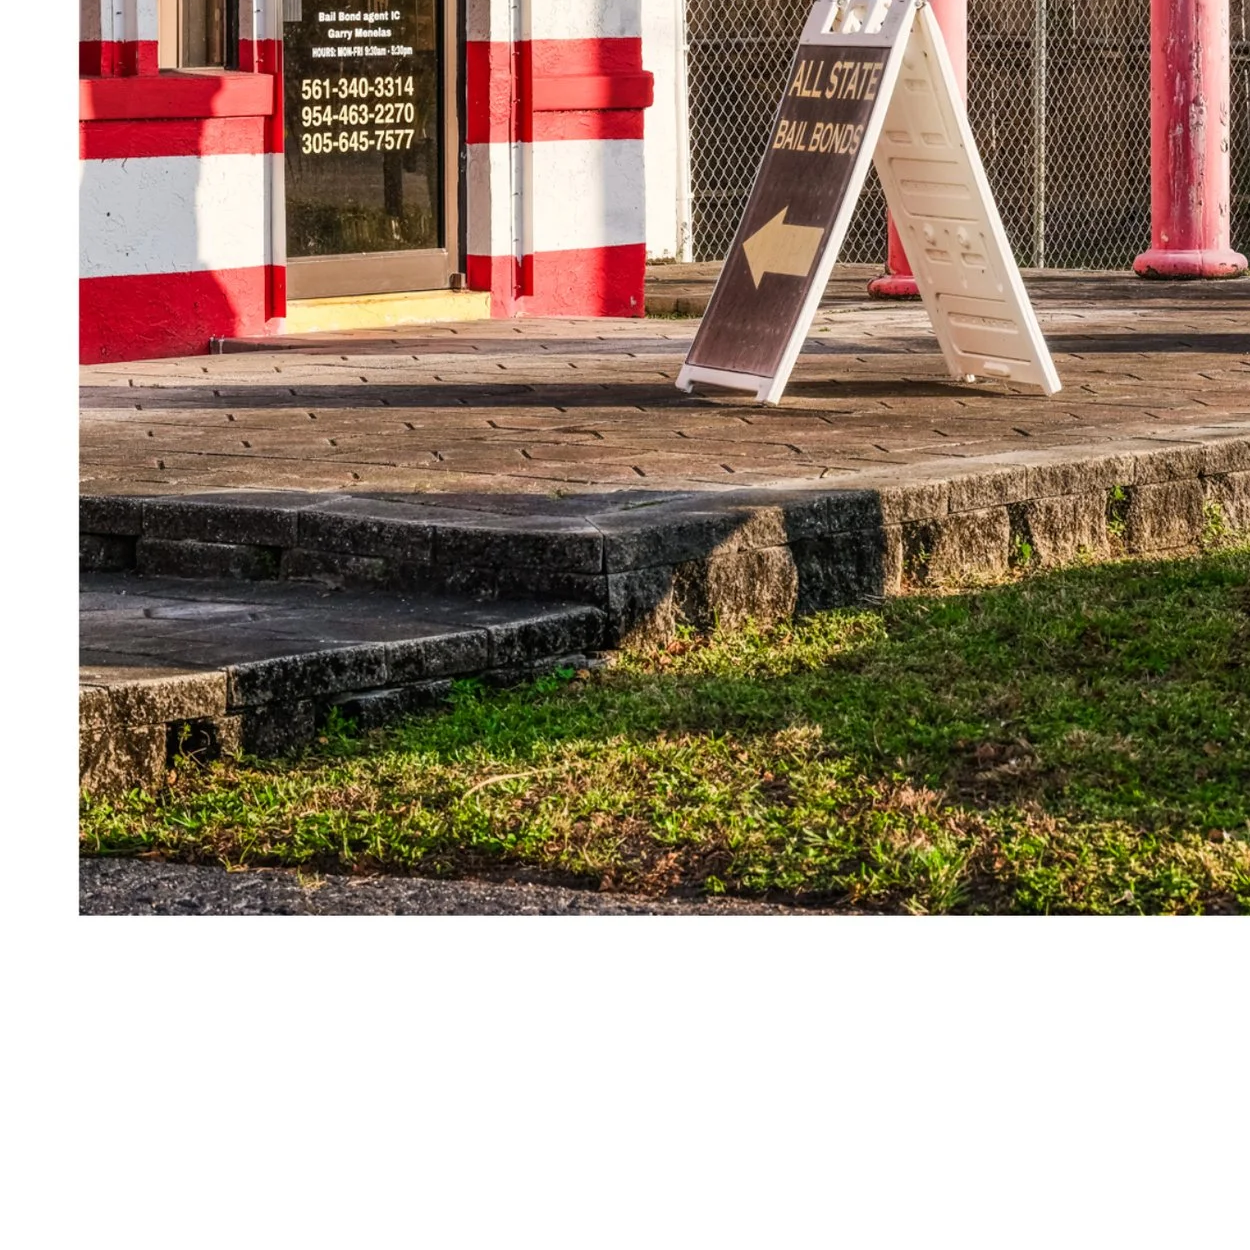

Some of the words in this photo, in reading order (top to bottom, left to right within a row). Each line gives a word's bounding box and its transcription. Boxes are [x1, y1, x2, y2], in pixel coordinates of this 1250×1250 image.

[318, 12, 336, 22] Bail
[338, 11, 361, 21] Bond
[363, 11, 389, 23] agent
[328, 28, 353, 40] Garry
[312, 46, 337, 58] HOURS:
[337, 46, 363, 57] MON-FRI
[301, 76, 414, 100] 561-340-3314
[788, 60, 824, 98] ALL
[825, 60, 883, 100] STATE
[301, 102, 415, 128] 954-463-2270
[301, 129, 415, 154] 305-645-7577
[773, 119, 808, 151] BAIL
[808, 122, 864, 155] BONDS
